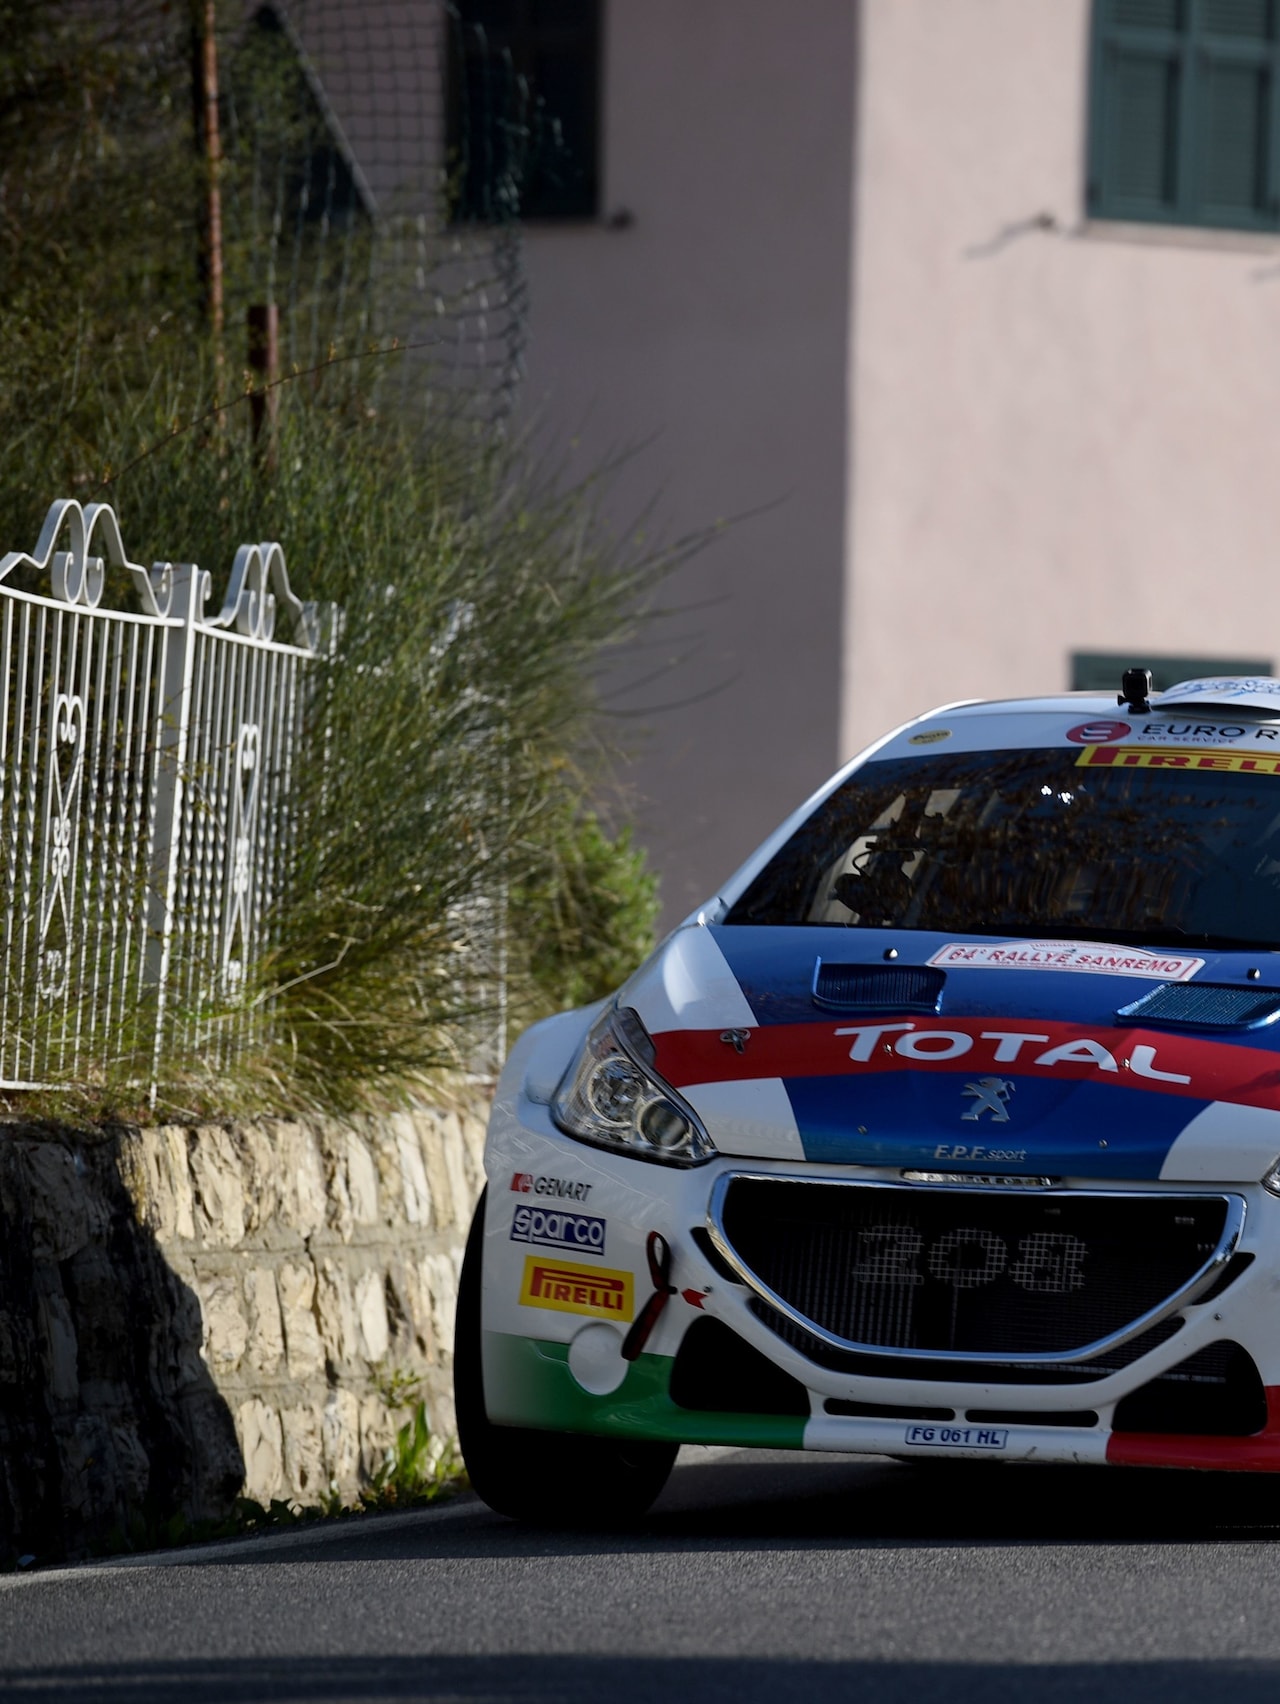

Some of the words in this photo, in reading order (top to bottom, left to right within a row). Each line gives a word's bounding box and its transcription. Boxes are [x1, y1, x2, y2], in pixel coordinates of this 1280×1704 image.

[1142, 723, 1246, 738] EURO
[1173, 736, 1236, 744] SERVICE
[987, 949, 1075, 964] RALLYE
[1075, 953, 1183, 973] SANREMO
[834, 1022, 1192, 1085] TOTAL
[534, 1176, 593, 1202] GENART
[514, 1208, 604, 1246] sparco
[851, 1225, 1088, 1293] 208
[529, 1266, 625, 1311] PIRELLI
[911, 1427, 936, 1441] FG
[940, 1429, 971, 1443] 061
[977, 1431, 1000, 1445] HL
